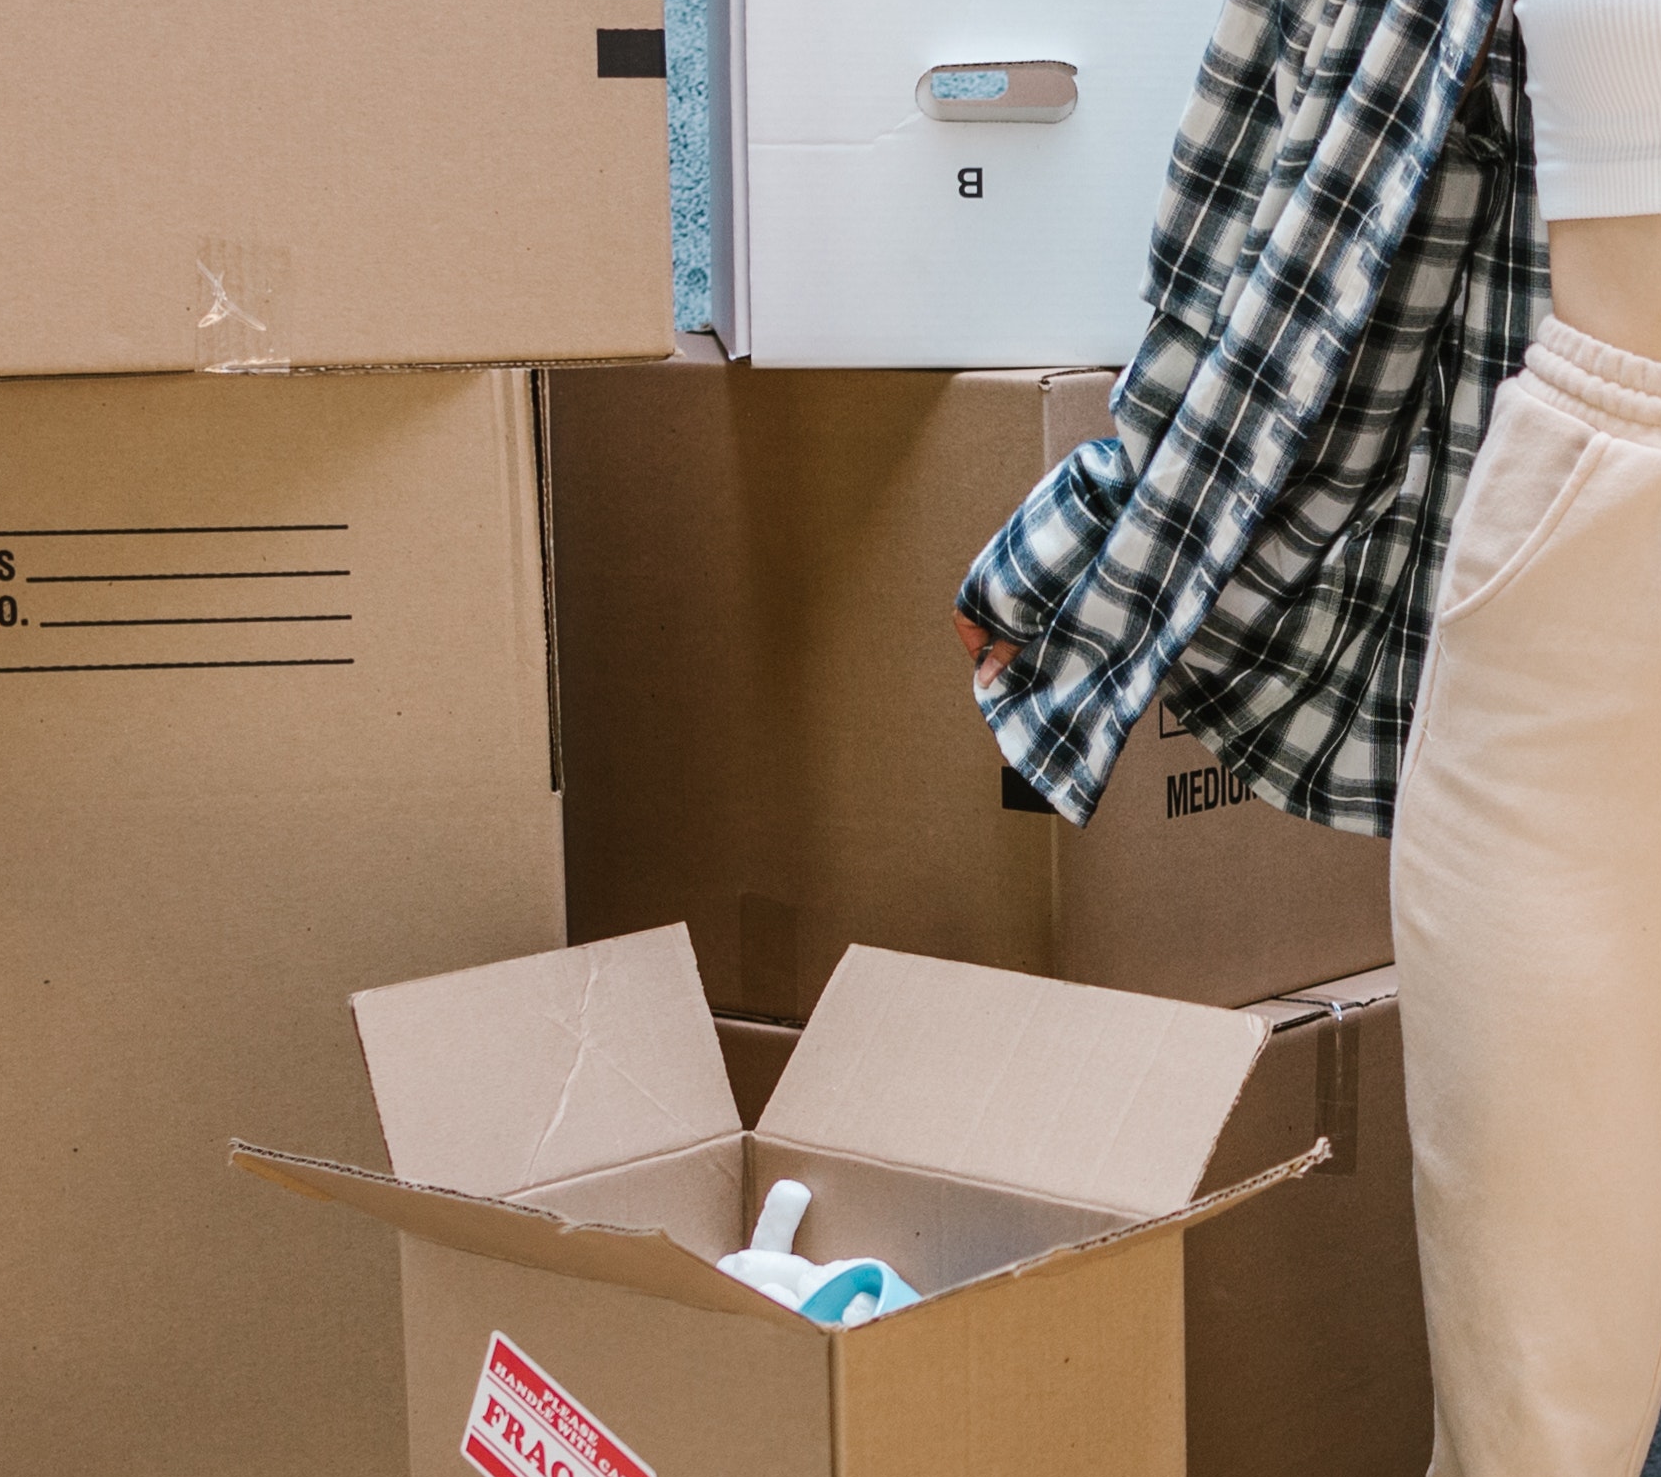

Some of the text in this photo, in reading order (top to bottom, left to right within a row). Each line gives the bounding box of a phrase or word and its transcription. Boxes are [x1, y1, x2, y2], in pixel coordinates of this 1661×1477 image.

[957, 167, 983, 198] B
[494, 1361, 555, 1423] HANDLE
[557, 1418, 598, 1462] WITH
[542, 1389, 599, 1447] PLEASE
